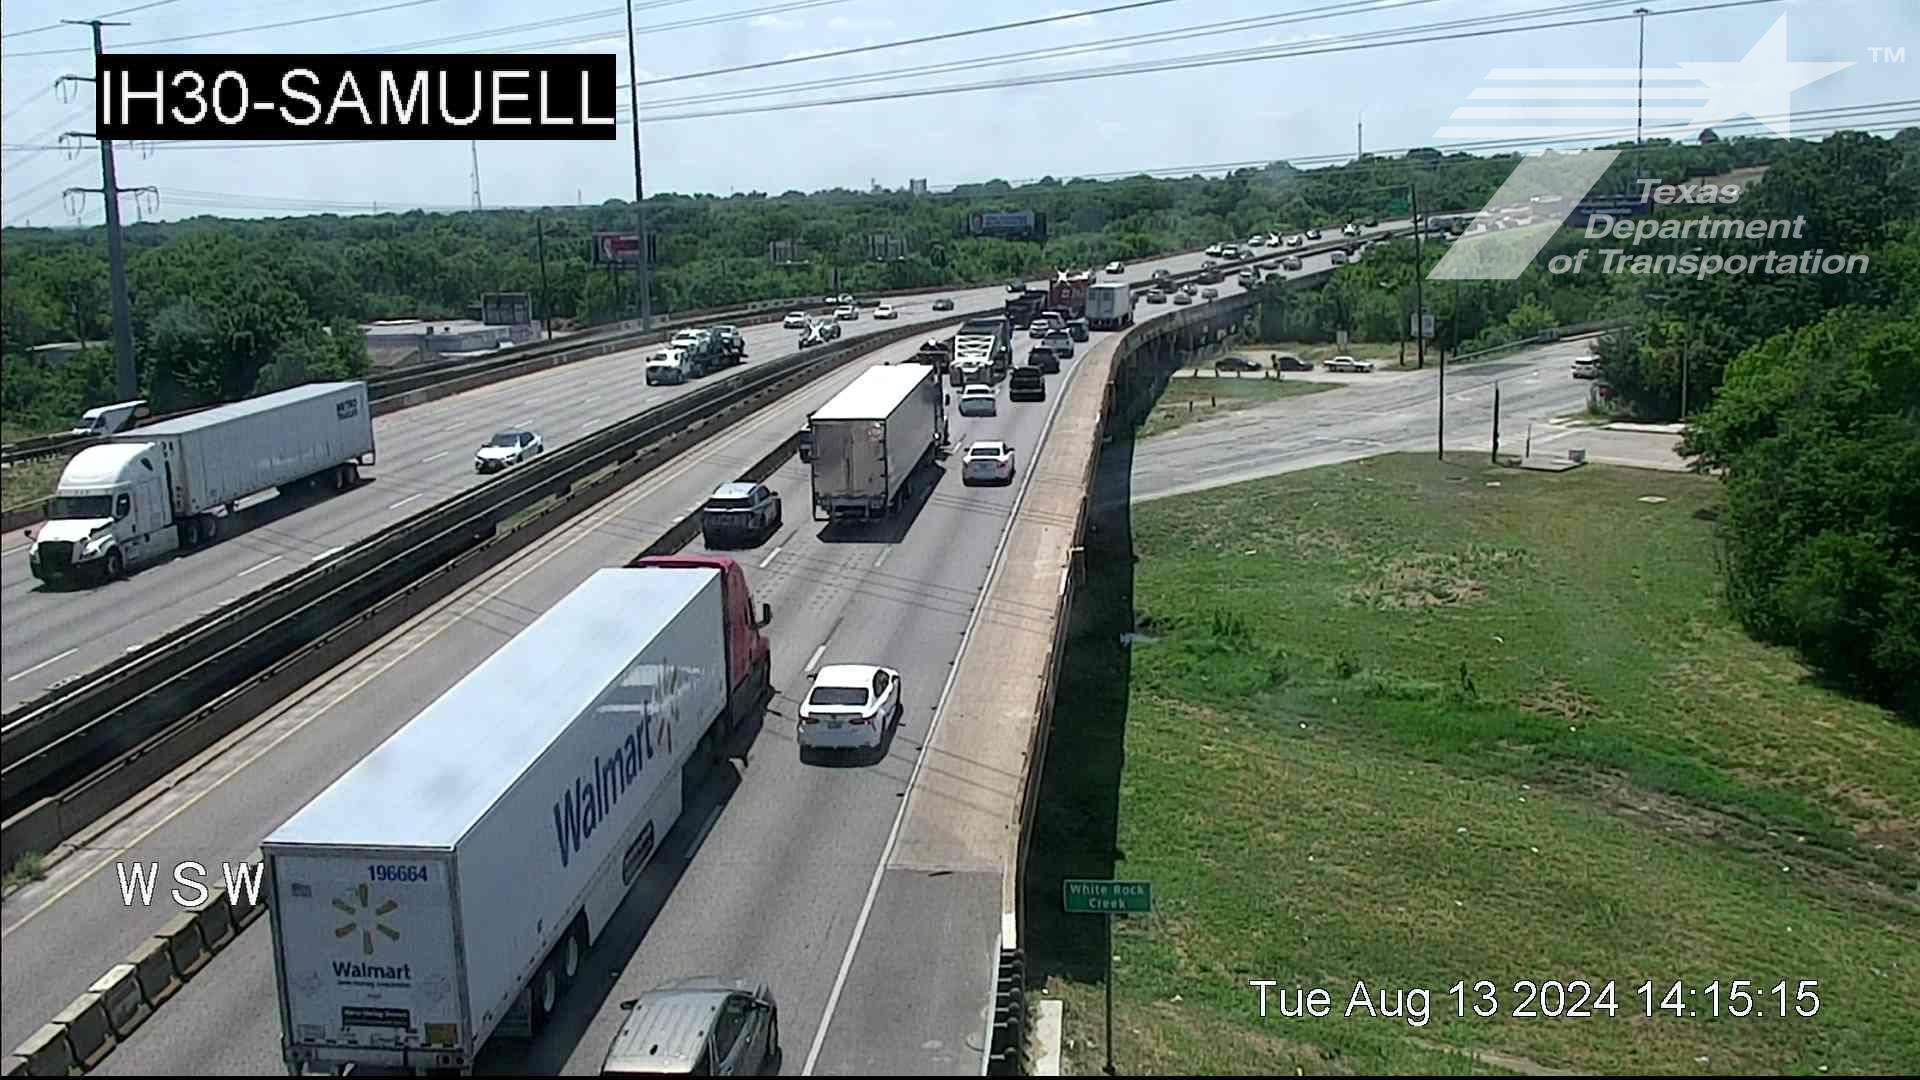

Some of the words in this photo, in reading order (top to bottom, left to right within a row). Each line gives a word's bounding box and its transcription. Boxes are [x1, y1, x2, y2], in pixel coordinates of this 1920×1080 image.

[553, 700, 654, 868] Walmart
[368, 865, 428, 882] 196664
[1070, 883, 1108, 896] White
[1113, 884, 1145, 896] Rock
[1088, 897, 1125, 909] Creek
[332, 960, 412, 981] Walmart
